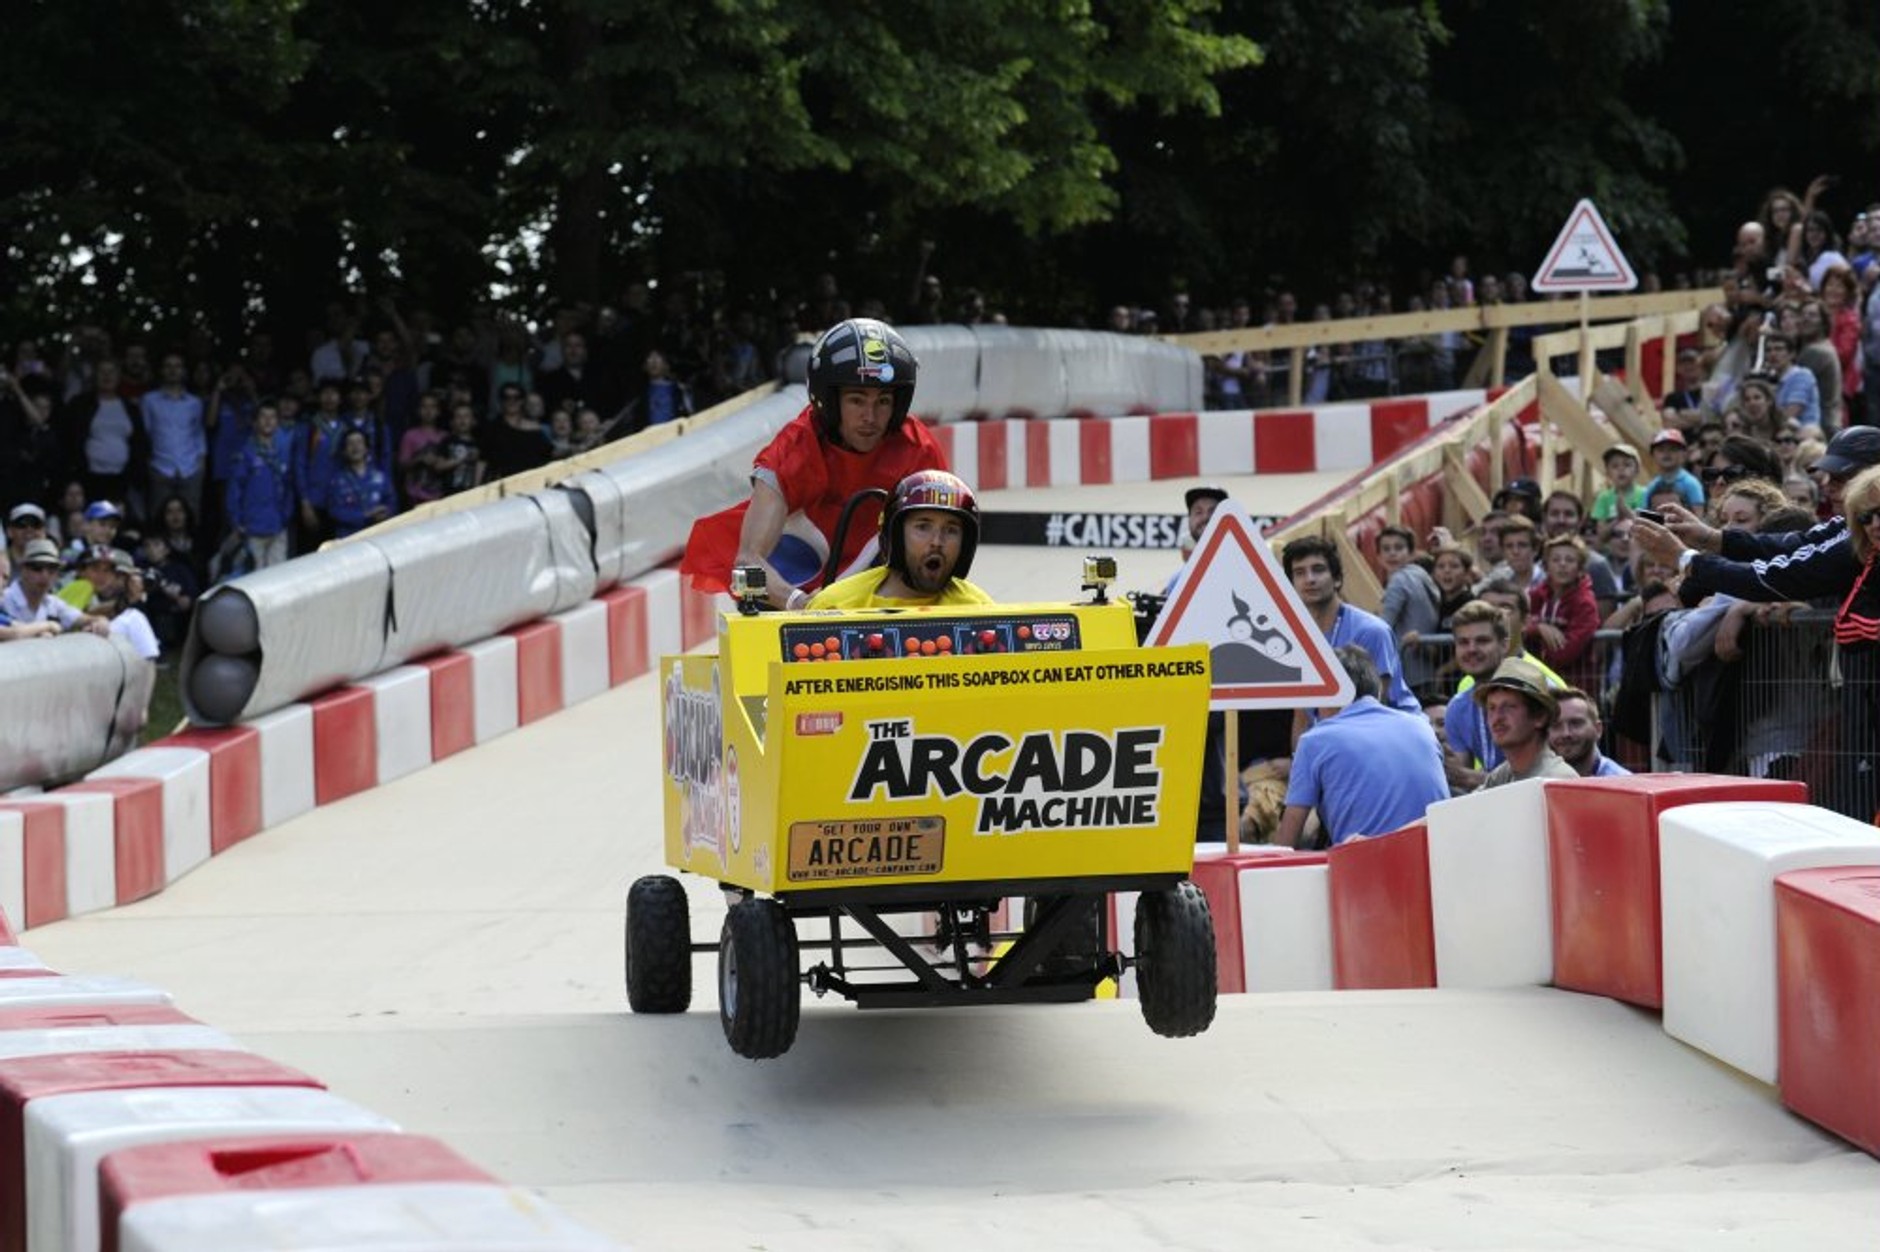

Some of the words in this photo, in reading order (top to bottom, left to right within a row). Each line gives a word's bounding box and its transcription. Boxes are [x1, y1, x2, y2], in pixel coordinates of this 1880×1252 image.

[785, 678, 833, 695] AFTER
[836, 674, 924, 694] ENERGISING
[926, 672, 960, 690] THIS
[963, 669, 1030, 686] SOAPBOX
[1033, 667, 1063, 683] CAN
[1066, 665, 1094, 682] EAT
[1096, 663, 1144, 680] OTHER
[1147, 660, 1205, 678] RACERS
[869, 720, 910, 740] THE
[850, 727, 1162, 801] ARCADE
[853, 822, 881, 835] YOUR
[978, 793, 1157, 833] MACHINE
[808, 834, 923, 867] ARCADE
